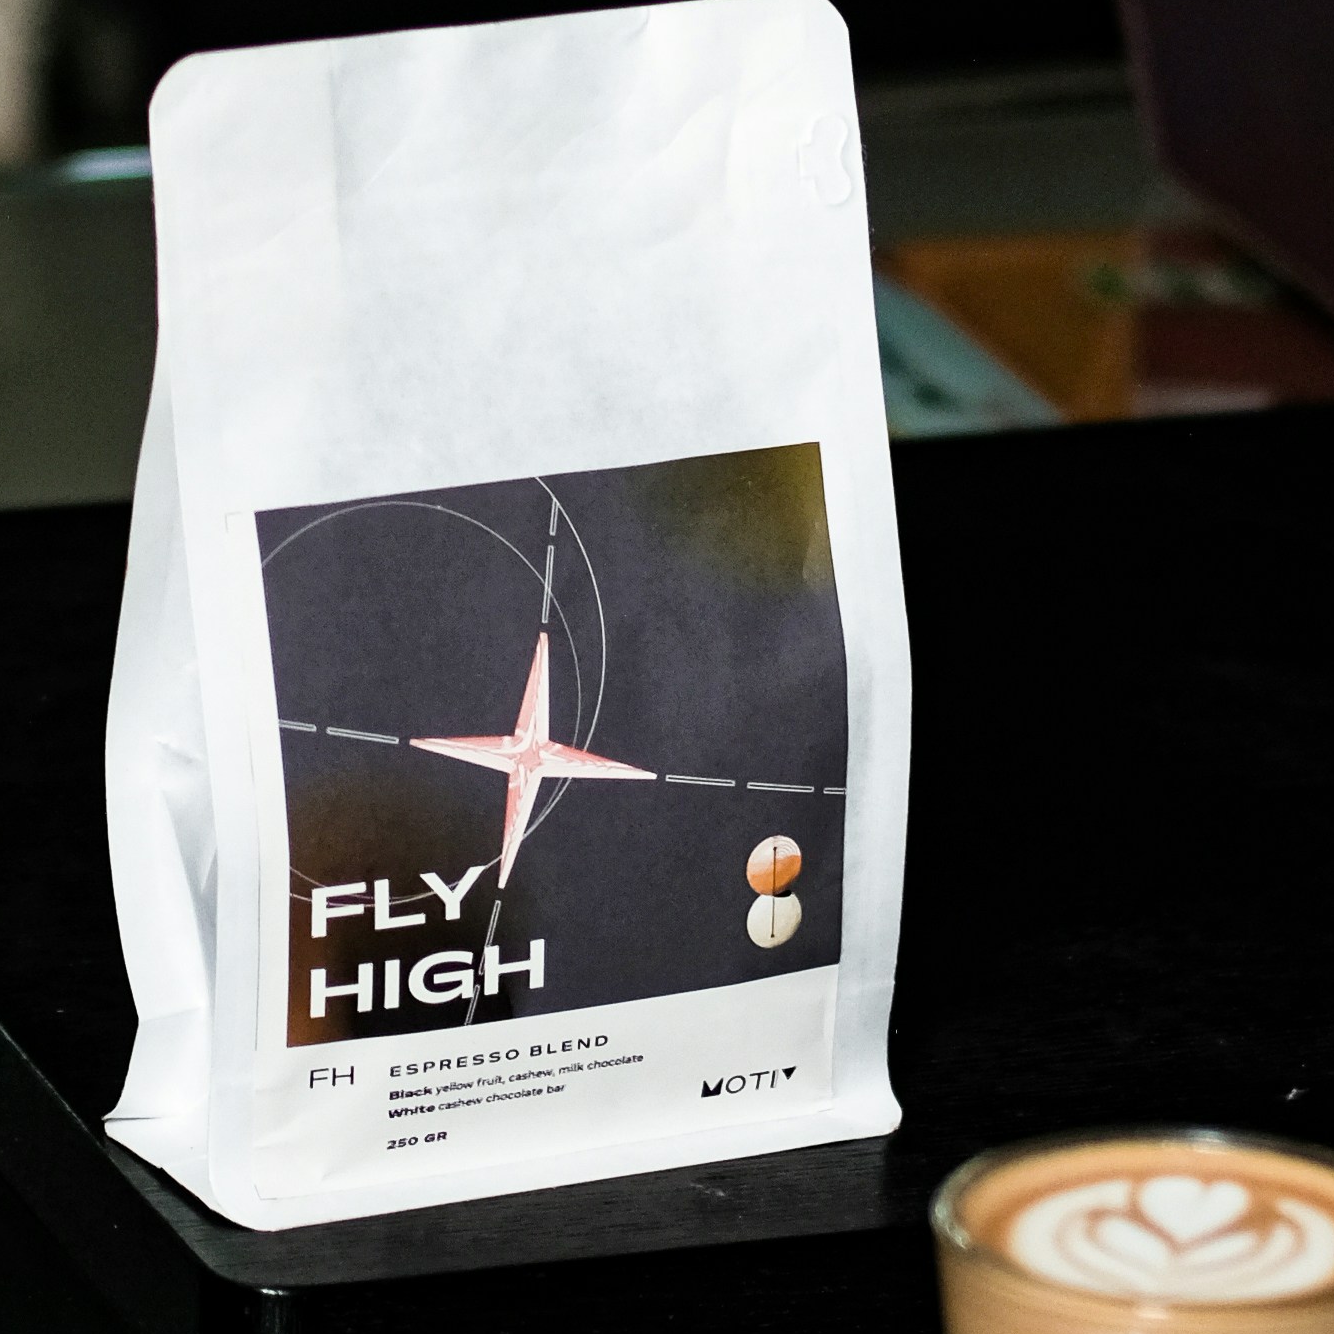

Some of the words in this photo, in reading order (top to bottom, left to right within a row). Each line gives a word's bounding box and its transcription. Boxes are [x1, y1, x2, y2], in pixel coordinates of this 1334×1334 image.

[311, 865, 486, 939] FLY
[310, 938, 545, 1019] HIGH
[390, 1048, 520, 1078] ESPRESSO
[529, 1034, 609, 1058] BLEND
[309, 1065, 355, 1089] FH
[389, 1085, 433, 1102] Black
[435, 1078, 474, 1097] yellow
[476, 1071, 505, 1089] fruit,
[508, 1067, 556, 1084] cashew,
[558, 1061, 584, 1076] milk
[586, 1053, 644, 1071] chocolate
[701, 1065, 797, 1099] MOTIV
[388, 1102, 436, 1120] White
[438, 1095, 483, 1112] cashew
[485, 1086, 544, 1105] chocolate
[546, 1083, 566, 1095] bar
[386, 1135, 419, 1151] 250
[424, 1130, 448, 1144] GR
